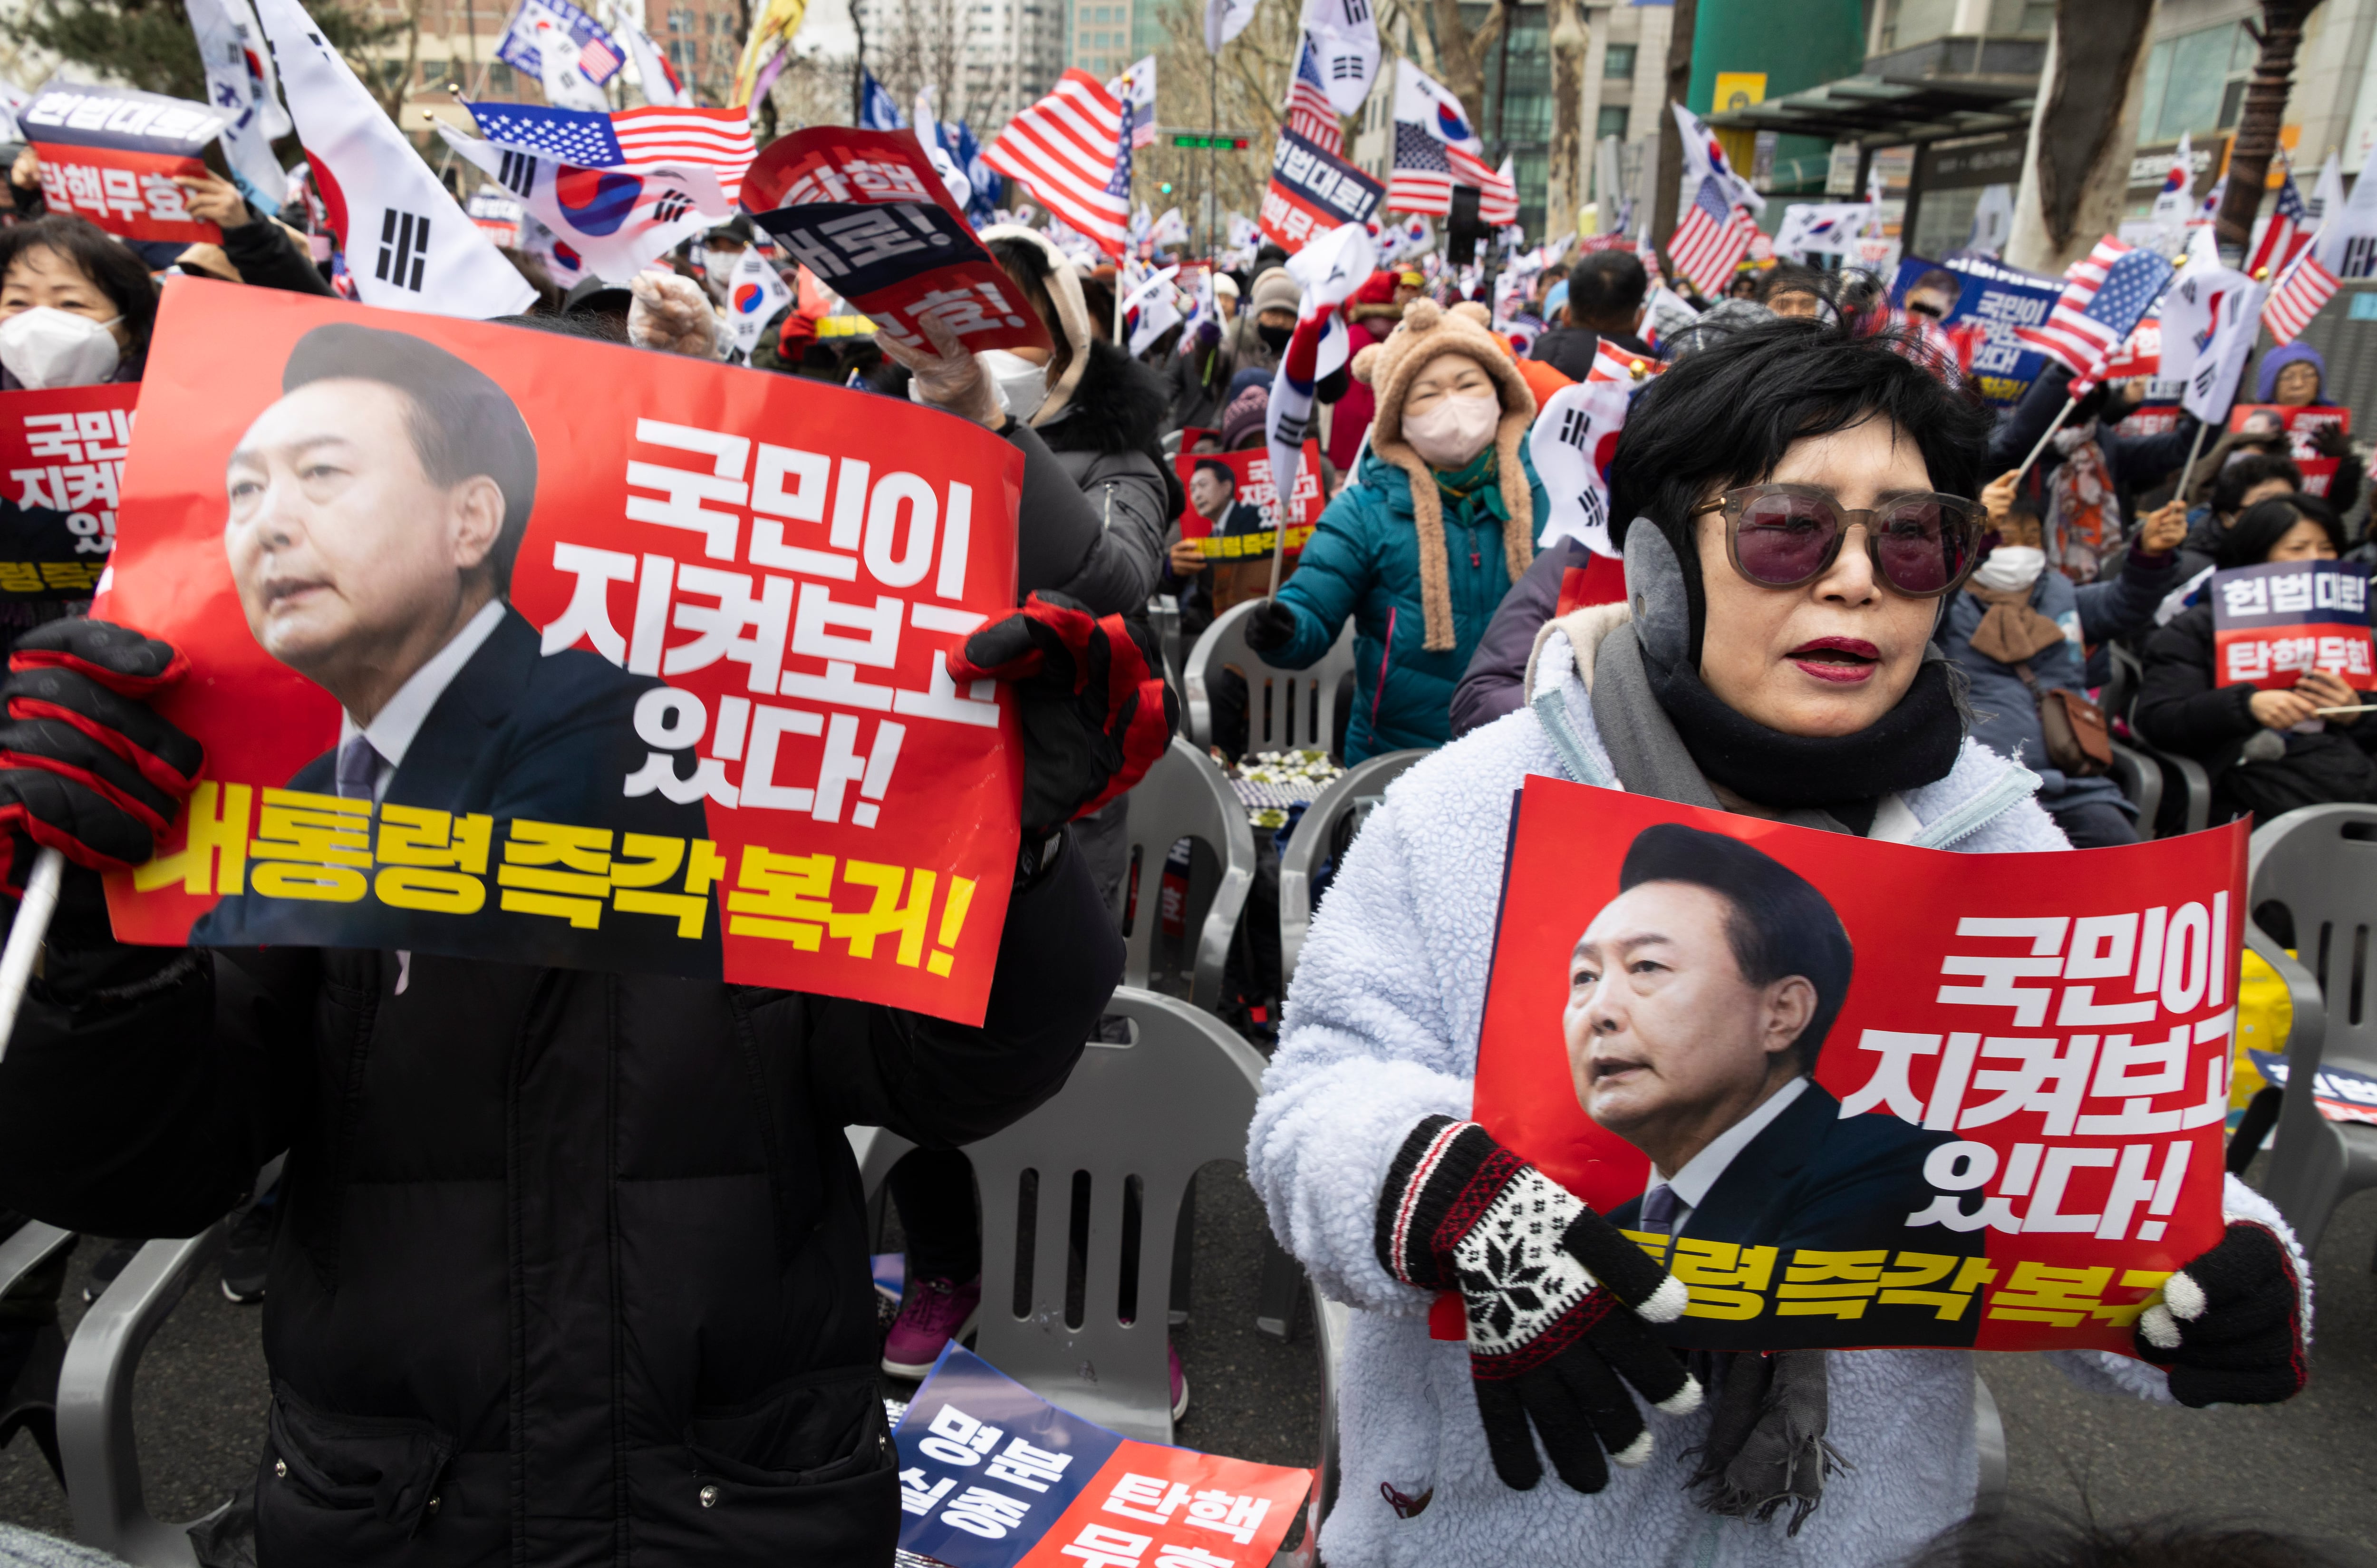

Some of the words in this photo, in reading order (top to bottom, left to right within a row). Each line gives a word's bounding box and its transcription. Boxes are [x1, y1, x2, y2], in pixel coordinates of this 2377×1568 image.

[26, 91, 225, 142] 헌법대로!
[23, 408, 137, 463] 국민
[10, 460, 125, 512] 지켜
[625, 416, 973, 601] 국민이
[540, 540, 1001, 729] 지켜보고
[2221, 571, 2366, 618] 헌법대로!
[623, 686, 907, 830] 있다!
[497, 817, 725, 940] 즉각
[726, 844, 977, 979] 복귀!
[1935, 890, 2228, 1027] 국민이
[1838, 1004, 2236, 1137] 지켜보고
[1904, 1140, 2193, 1241] 있다!
[1775, 1249, 1997, 1321] 즉각
[918, 1403, 1074, 1494] 명분
[898, 1466, 1031, 1539] 실종
[1101, 1472, 1272, 1545] 탄핵
